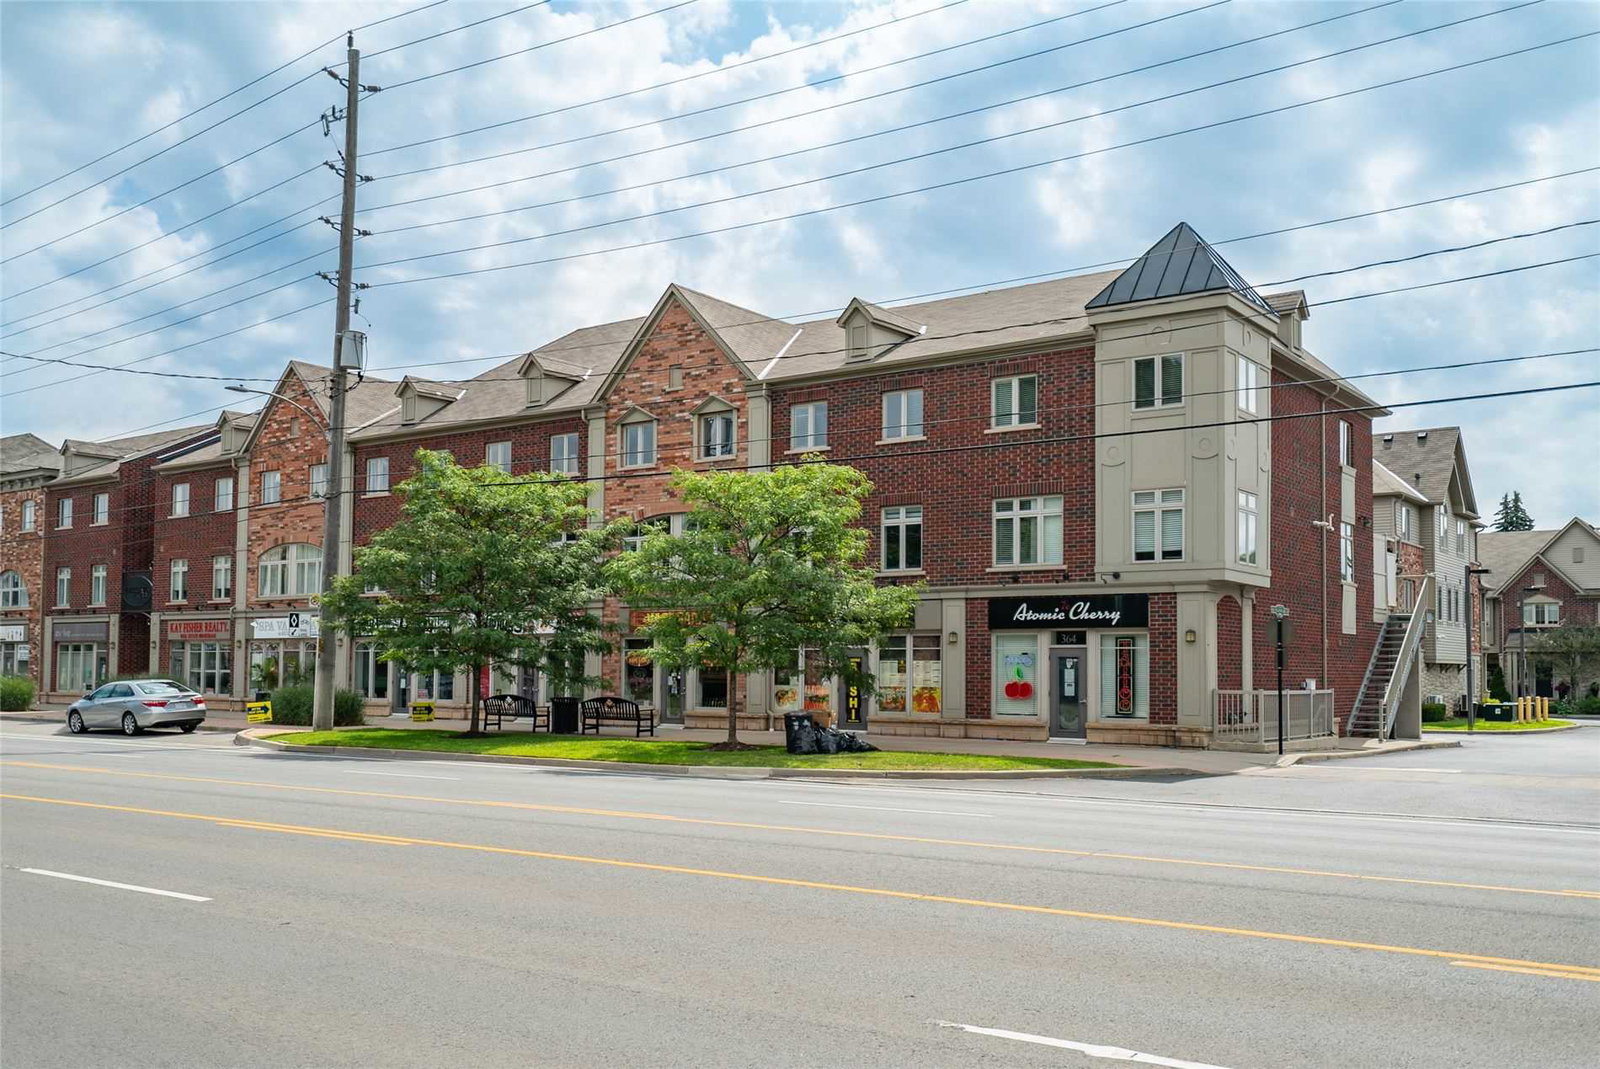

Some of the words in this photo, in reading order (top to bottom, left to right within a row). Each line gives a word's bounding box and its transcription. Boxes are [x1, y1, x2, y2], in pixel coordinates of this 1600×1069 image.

[1013, 603, 1065, 621] Atomic
[1069, 602, 1121, 625] Cherry
[170, 622, 182, 633] KAY
[183, 622, 203, 633] FISHER
[258, 621, 274, 631] SPA
[1061, 633, 1076, 644] 364
